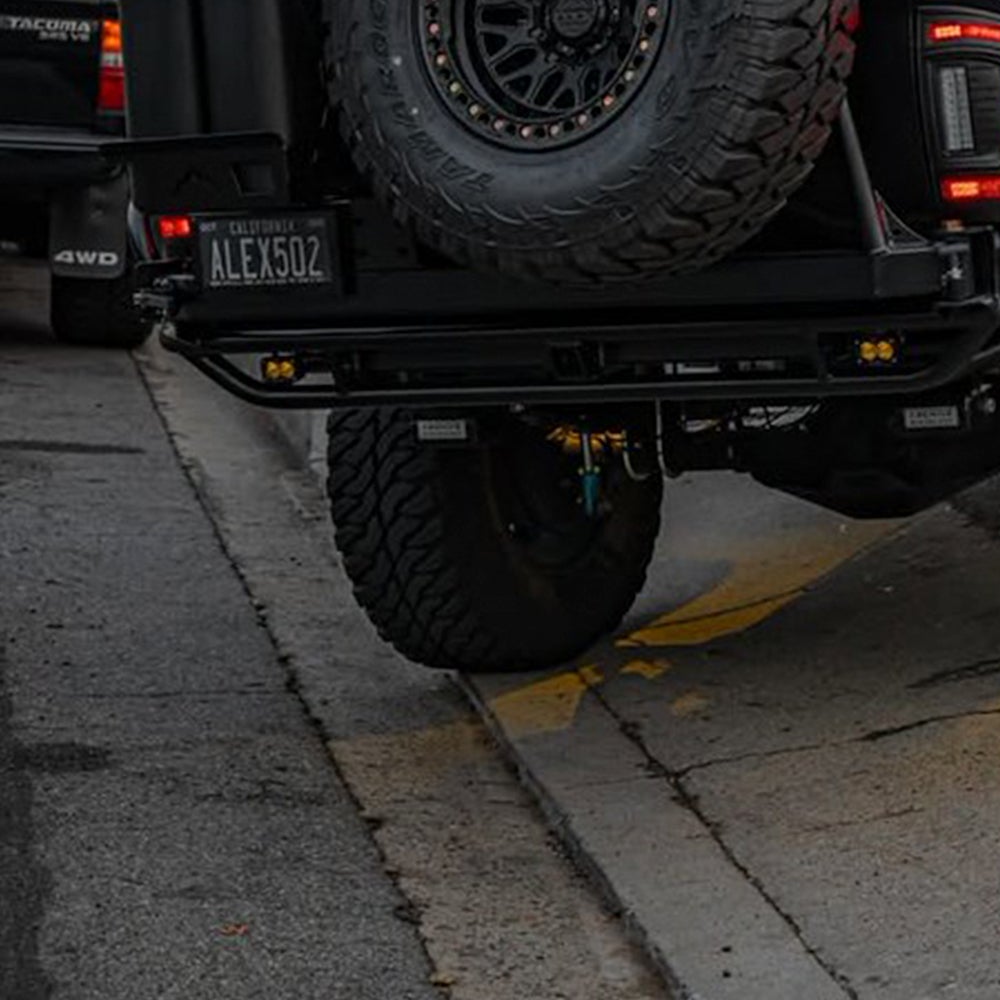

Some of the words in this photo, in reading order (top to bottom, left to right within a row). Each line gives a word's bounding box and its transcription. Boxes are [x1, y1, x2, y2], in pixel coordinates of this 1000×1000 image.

[7, 16, 91, 34] TACOMA
[53, 249, 119, 266] 4WD
[210, 235, 325, 280] ALEX502
